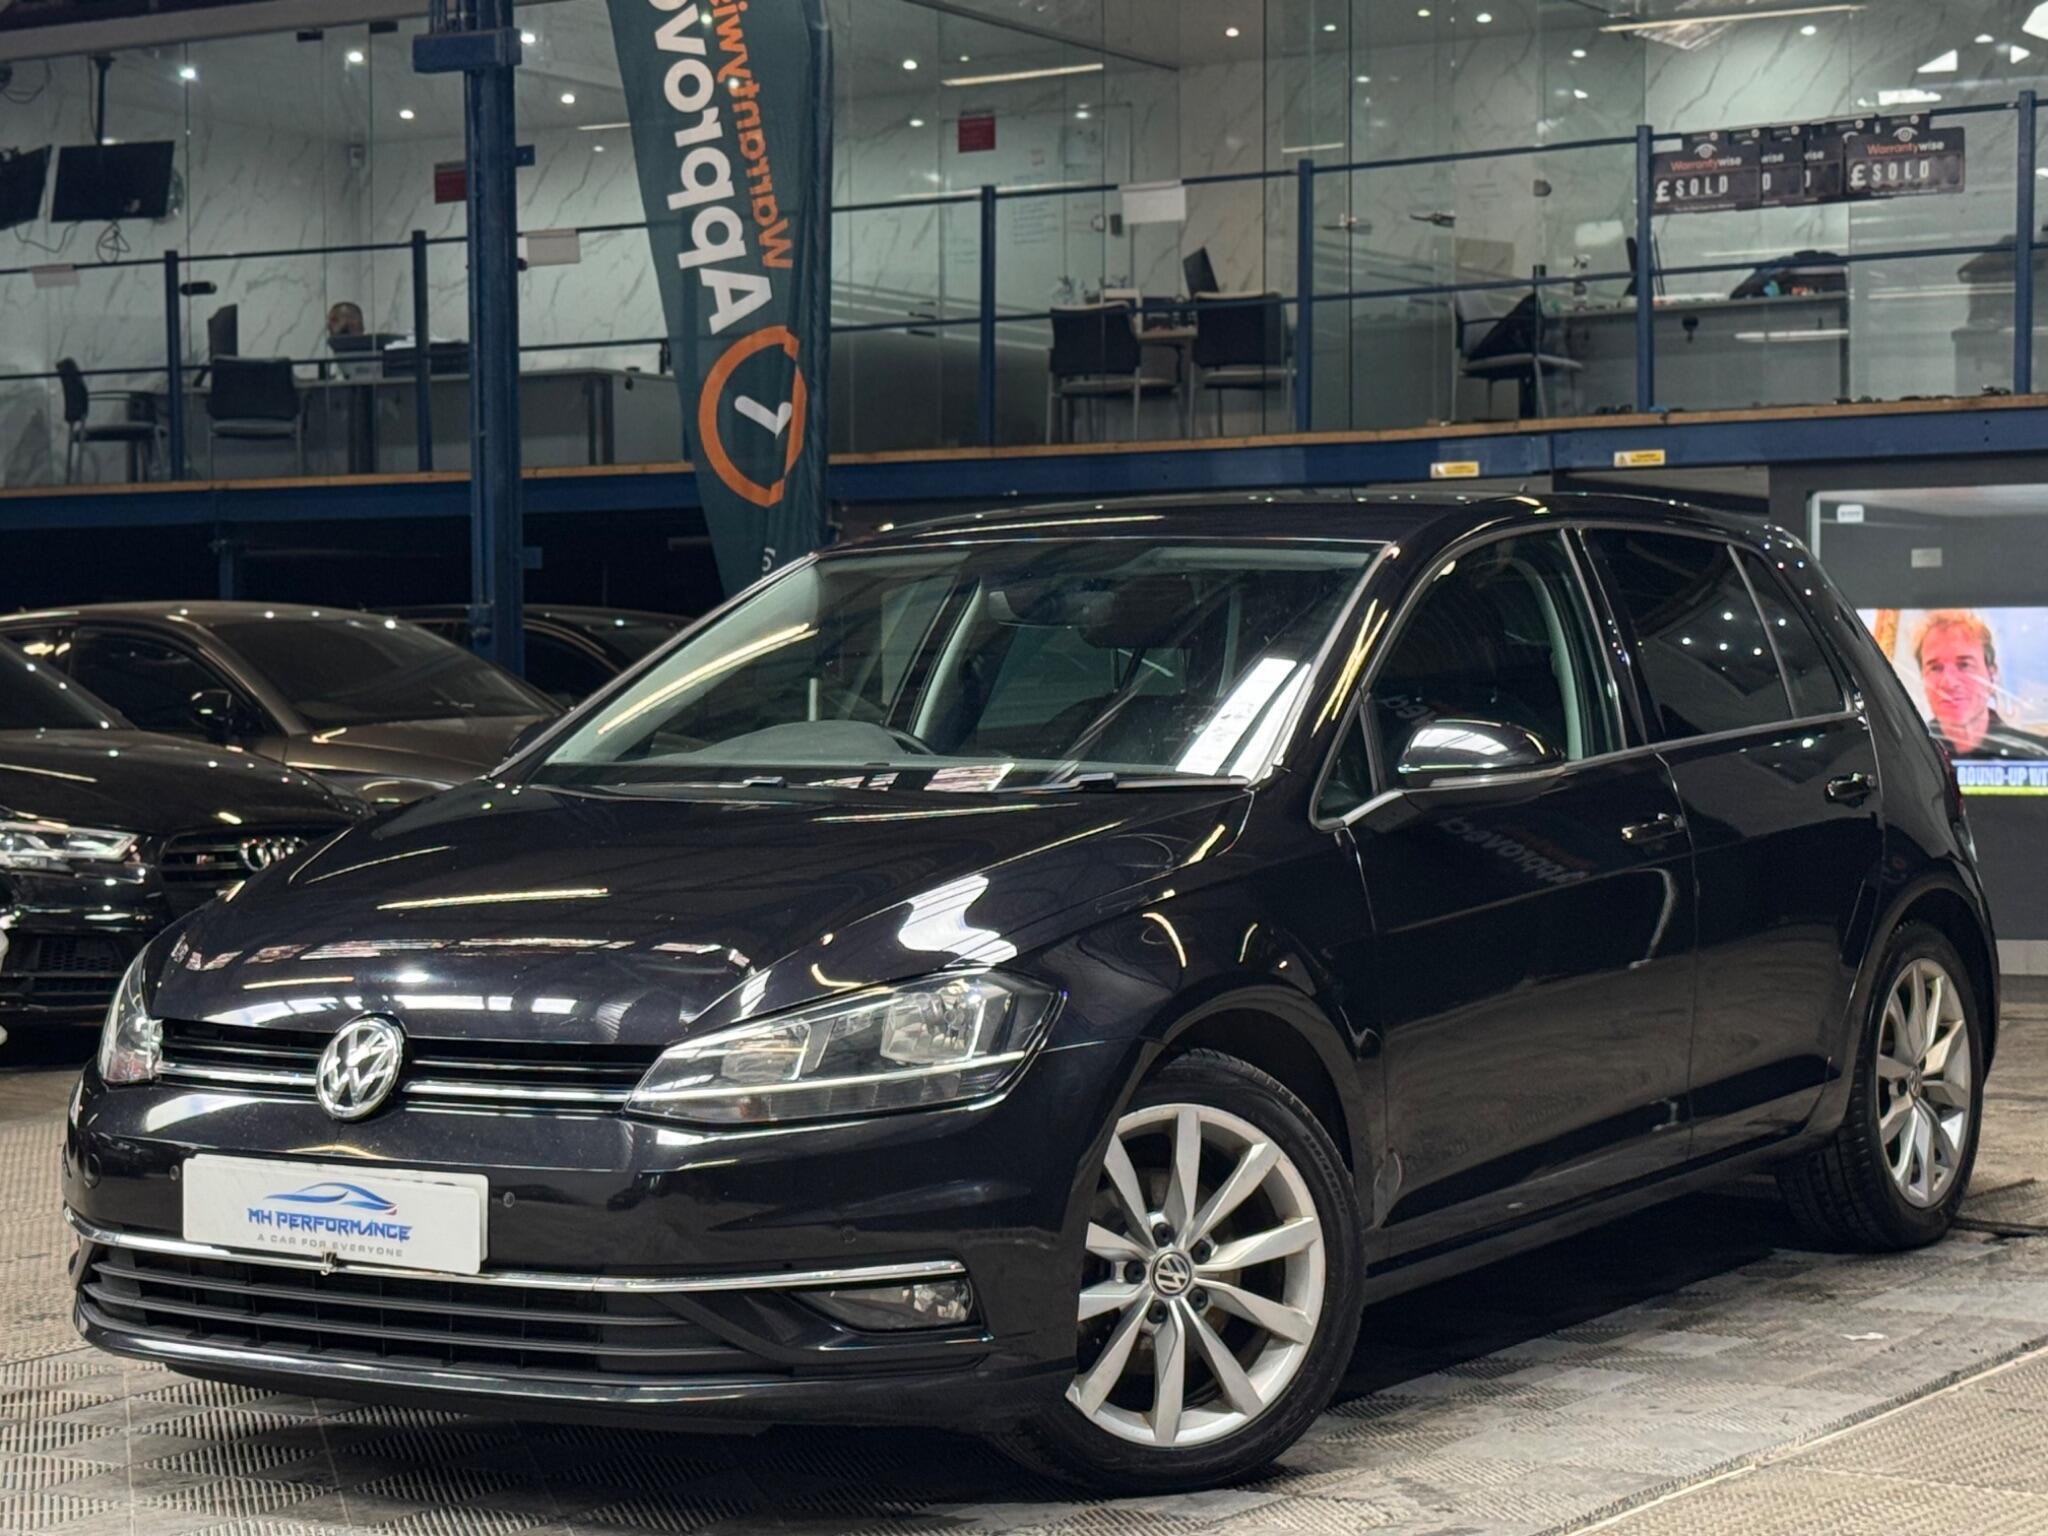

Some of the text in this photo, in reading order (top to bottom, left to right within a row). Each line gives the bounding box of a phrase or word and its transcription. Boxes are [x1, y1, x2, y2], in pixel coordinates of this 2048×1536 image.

[1867, 140, 1945, 156] Warrantywise
[1670, 156, 1742, 172] Warrantywise
[247, 1208, 412, 1242] MH PERFORMANCE
[271, 1234, 297, 1245] CAR
[301, 1237, 326, 1248] FOR
[332, 1242, 403, 1257] EVERYONE
